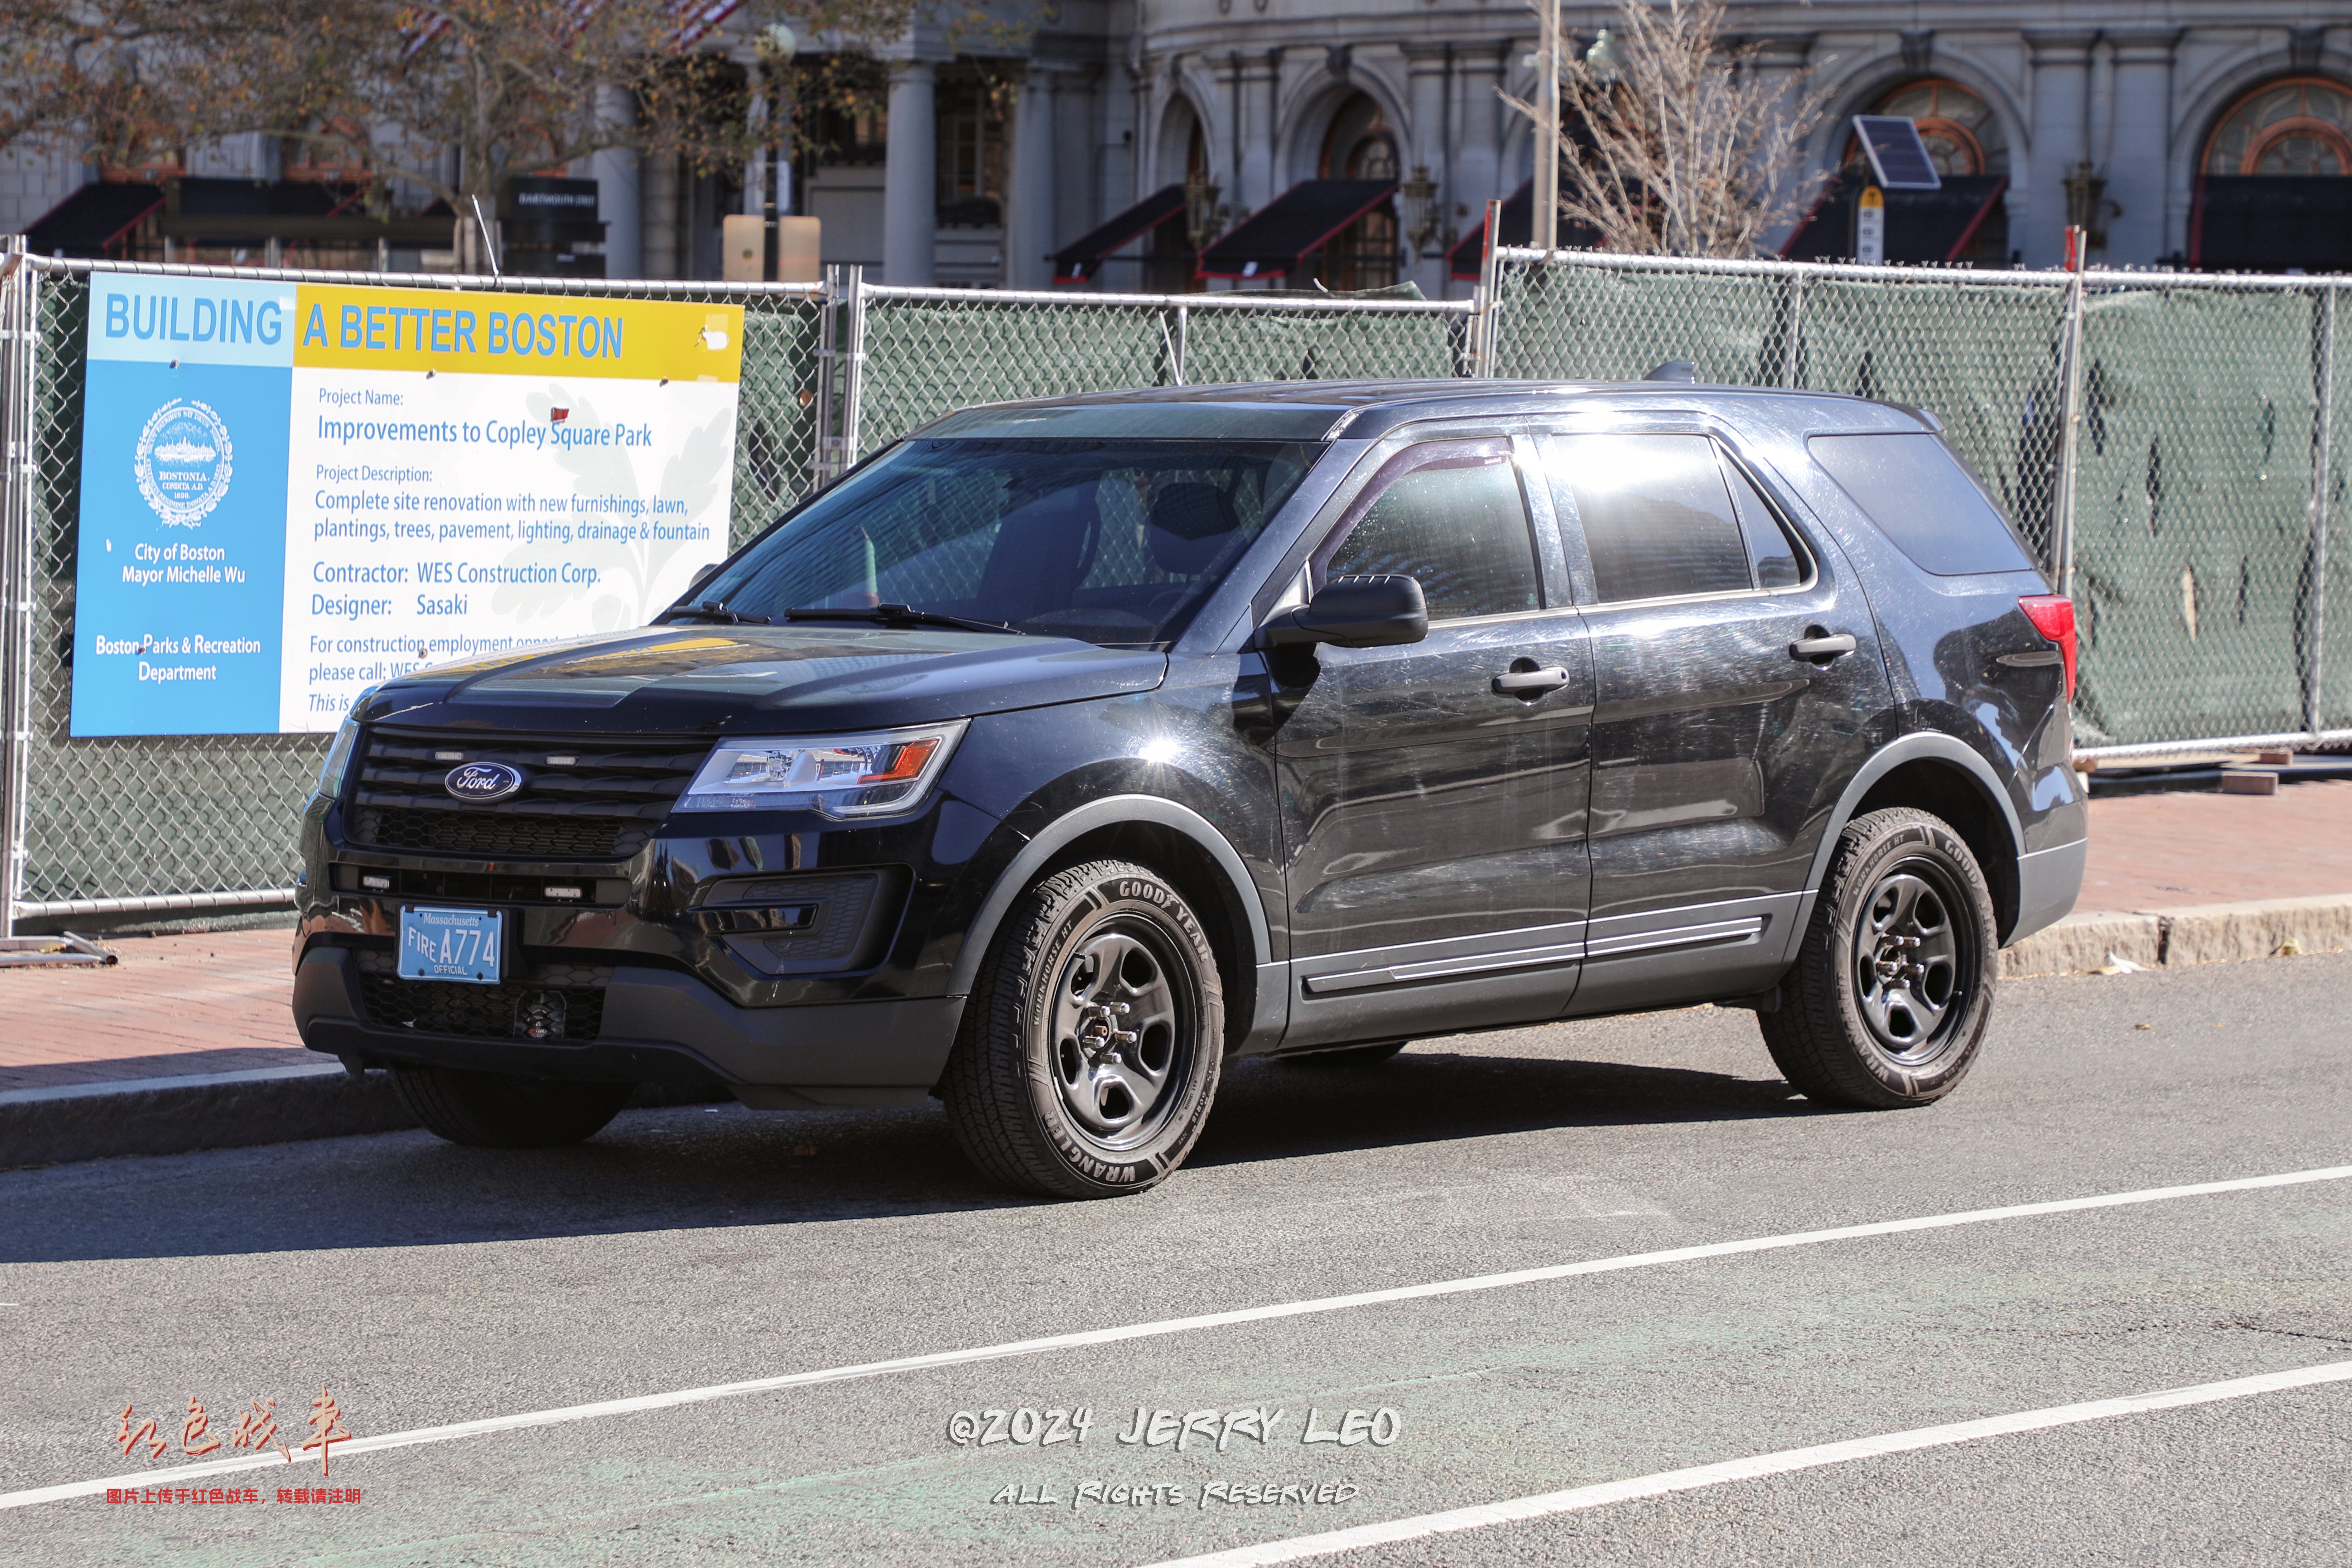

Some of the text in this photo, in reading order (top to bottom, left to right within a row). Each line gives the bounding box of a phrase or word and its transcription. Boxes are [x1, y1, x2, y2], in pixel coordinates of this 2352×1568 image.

[106, 293, 623, 358] BUILDING A BETTER BOSTON
[319, 388, 403, 408] Project Name:
[318, 415, 652, 451] Improvements to Copley Square Park
[162, 482, 190, 491] CONDITA
[316, 464, 432, 485] Project Description:
[315, 489, 688, 518] Complete site renovation with new furnishings, lawn,
[314, 517, 709, 545] plantings, trees, pavement, lighting, drainage & fountain
[135, 542, 225, 564] City of Boston
[122, 563, 246, 587] Mayor Michelle Wu
[313, 561, 600, 589] Contractor: WES Construction Corp.
[312, 593, 468, 621] Designer: Sasaki
[96, 633, 261, 655] Boston Parks & Recreation
[310, 635, 333, 653] For
[337, 635, 425, 653] construction
[429, 634, 513, 658] employment
[138, 661, 217, 685] Department
[309, 662, 355, 685] please
[359, 662, 386, 680] call:
[309, 693, 349, 711] This is
[457, 767, 500, 790] Ford
[1894, 834, 1904, 845] HT
[424, 913, 479, 926] Massachusetts
[408, 926, 495, 967] FIRE A774
[434, 965, 468, 975] OFFICIAL
[1034, 920, 1072, 1026] WORKHORSE HT
[1044, 1110, 1135, 1182] WRANGLER
